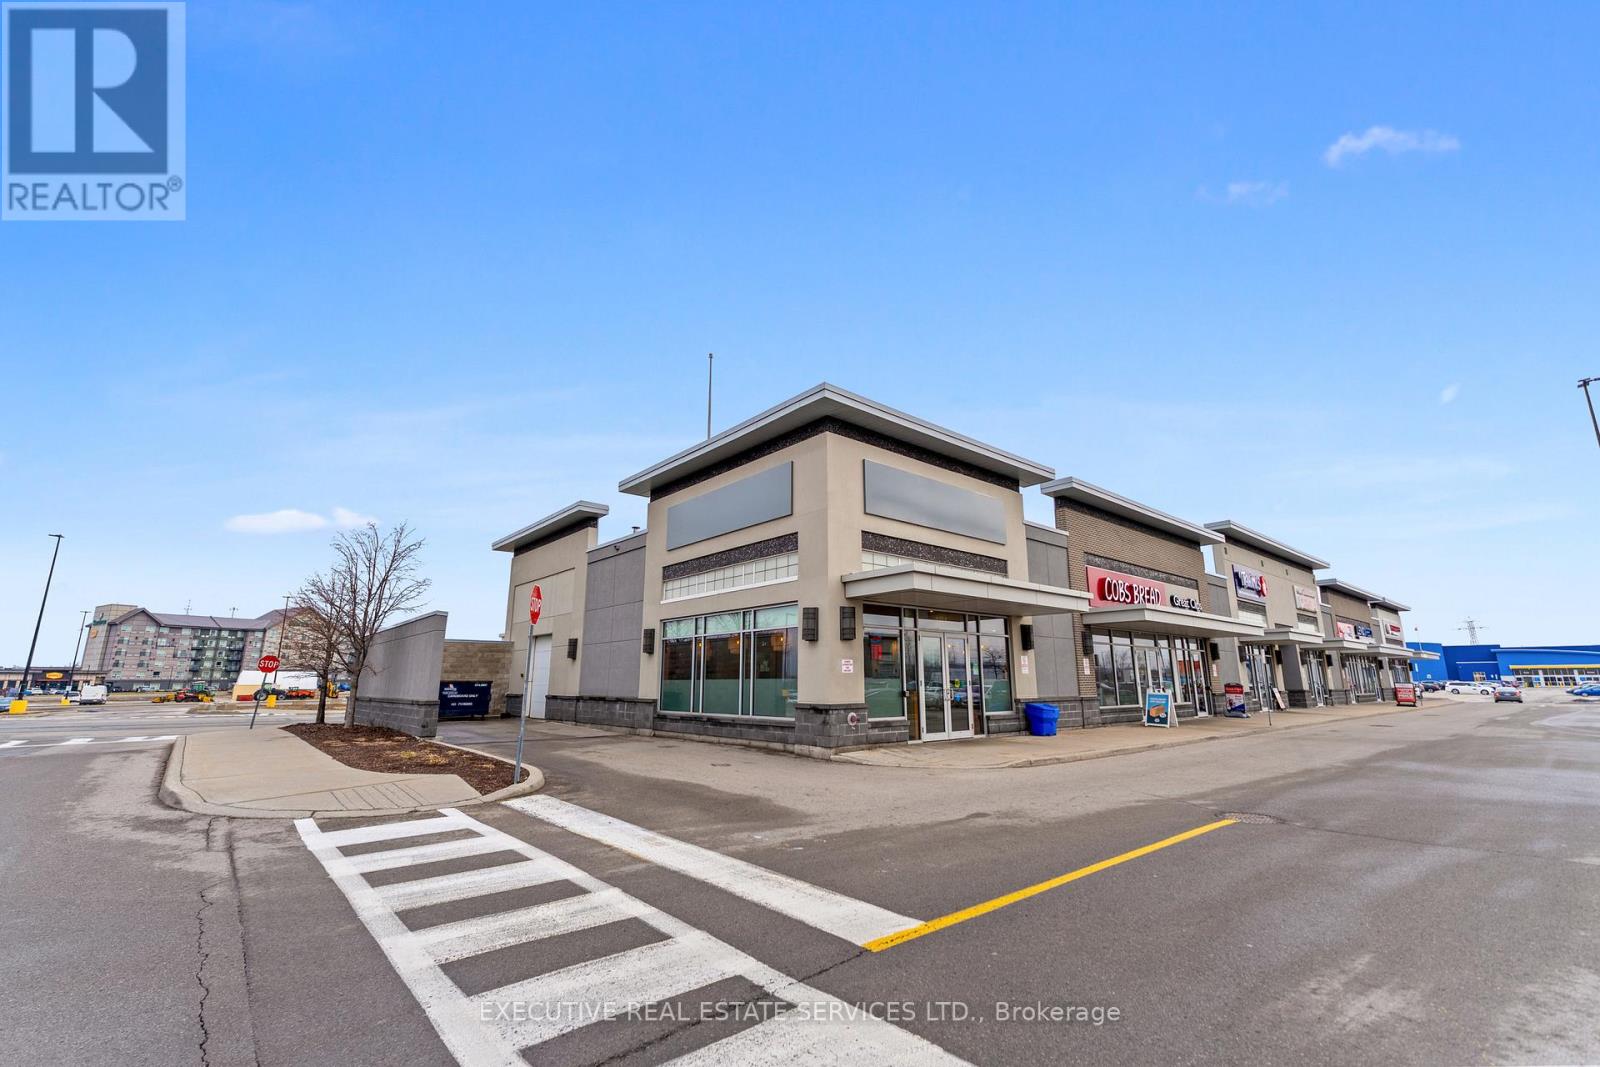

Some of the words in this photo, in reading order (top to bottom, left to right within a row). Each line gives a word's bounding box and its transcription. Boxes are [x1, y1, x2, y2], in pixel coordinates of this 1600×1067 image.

[1104, 577, 1131, 602] COBS
[1132, 584, 1161, 605] BREAD
[260, 660, 278, 668] STOP
